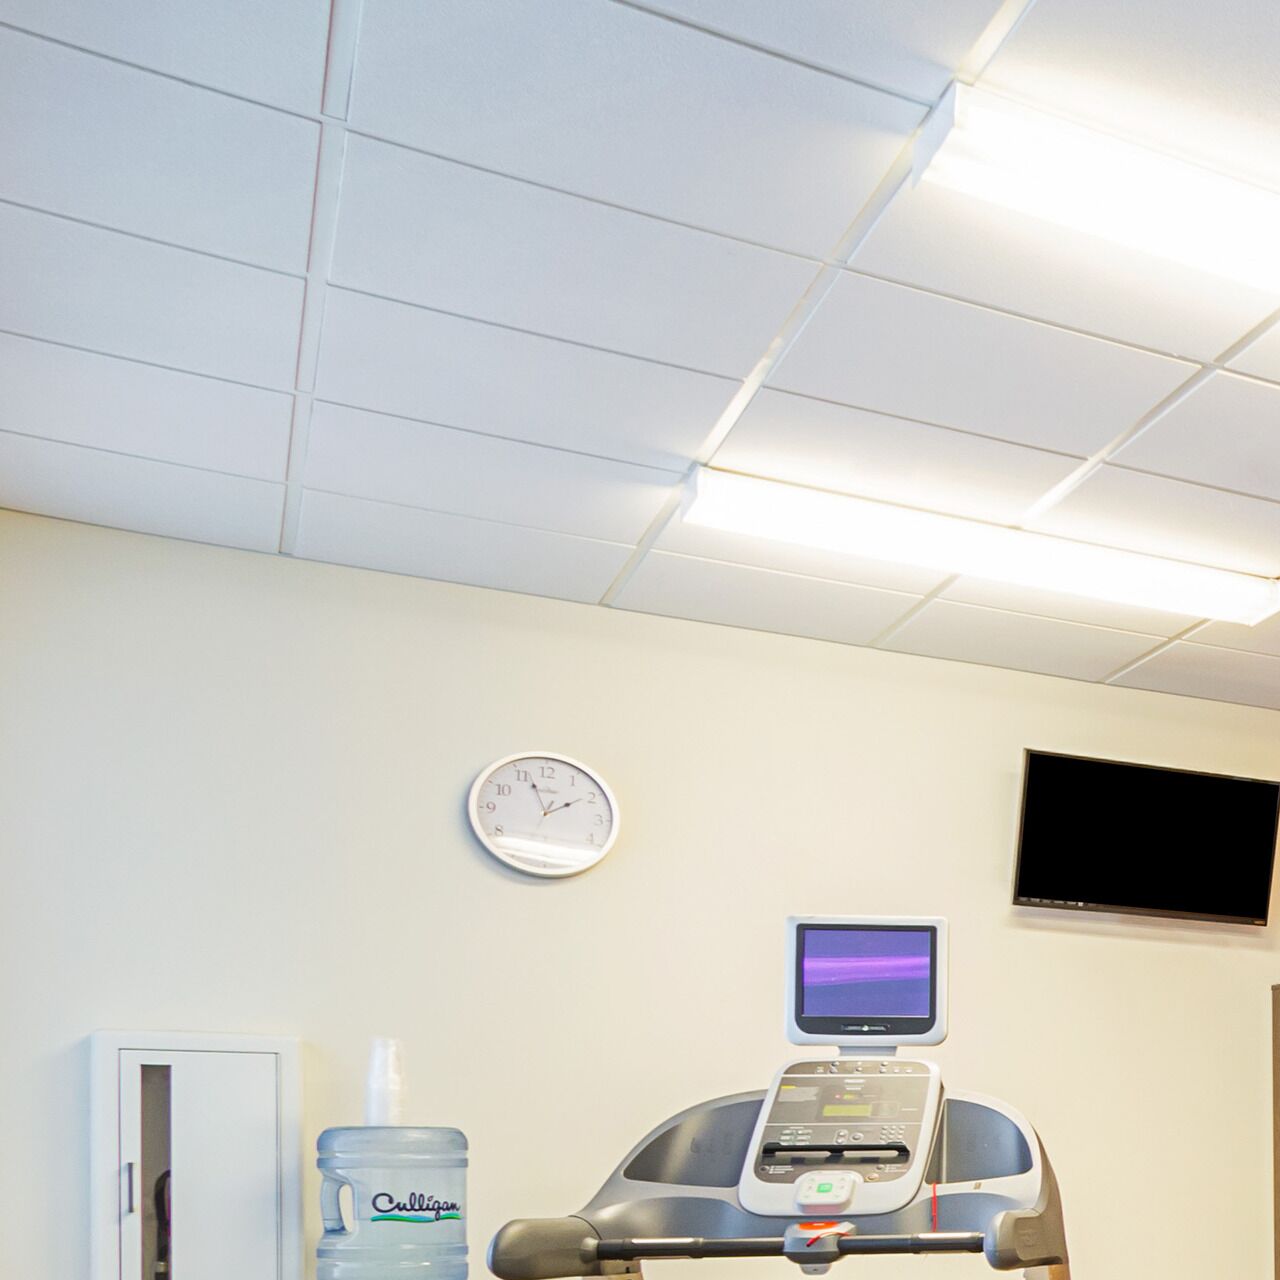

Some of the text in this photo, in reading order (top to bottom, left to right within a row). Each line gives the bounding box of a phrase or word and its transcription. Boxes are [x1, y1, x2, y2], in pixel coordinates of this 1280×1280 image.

[539, 766, 555, 779] 12
[570, 775, 575, 787] 1
[495, 783, 512, 796] 10
[587, 792, 596, 804] 2
[486, 801, 496, 814] 9
[494, 825, 504, 837] 8
[372, 1192, 460, 1221] Culligan
